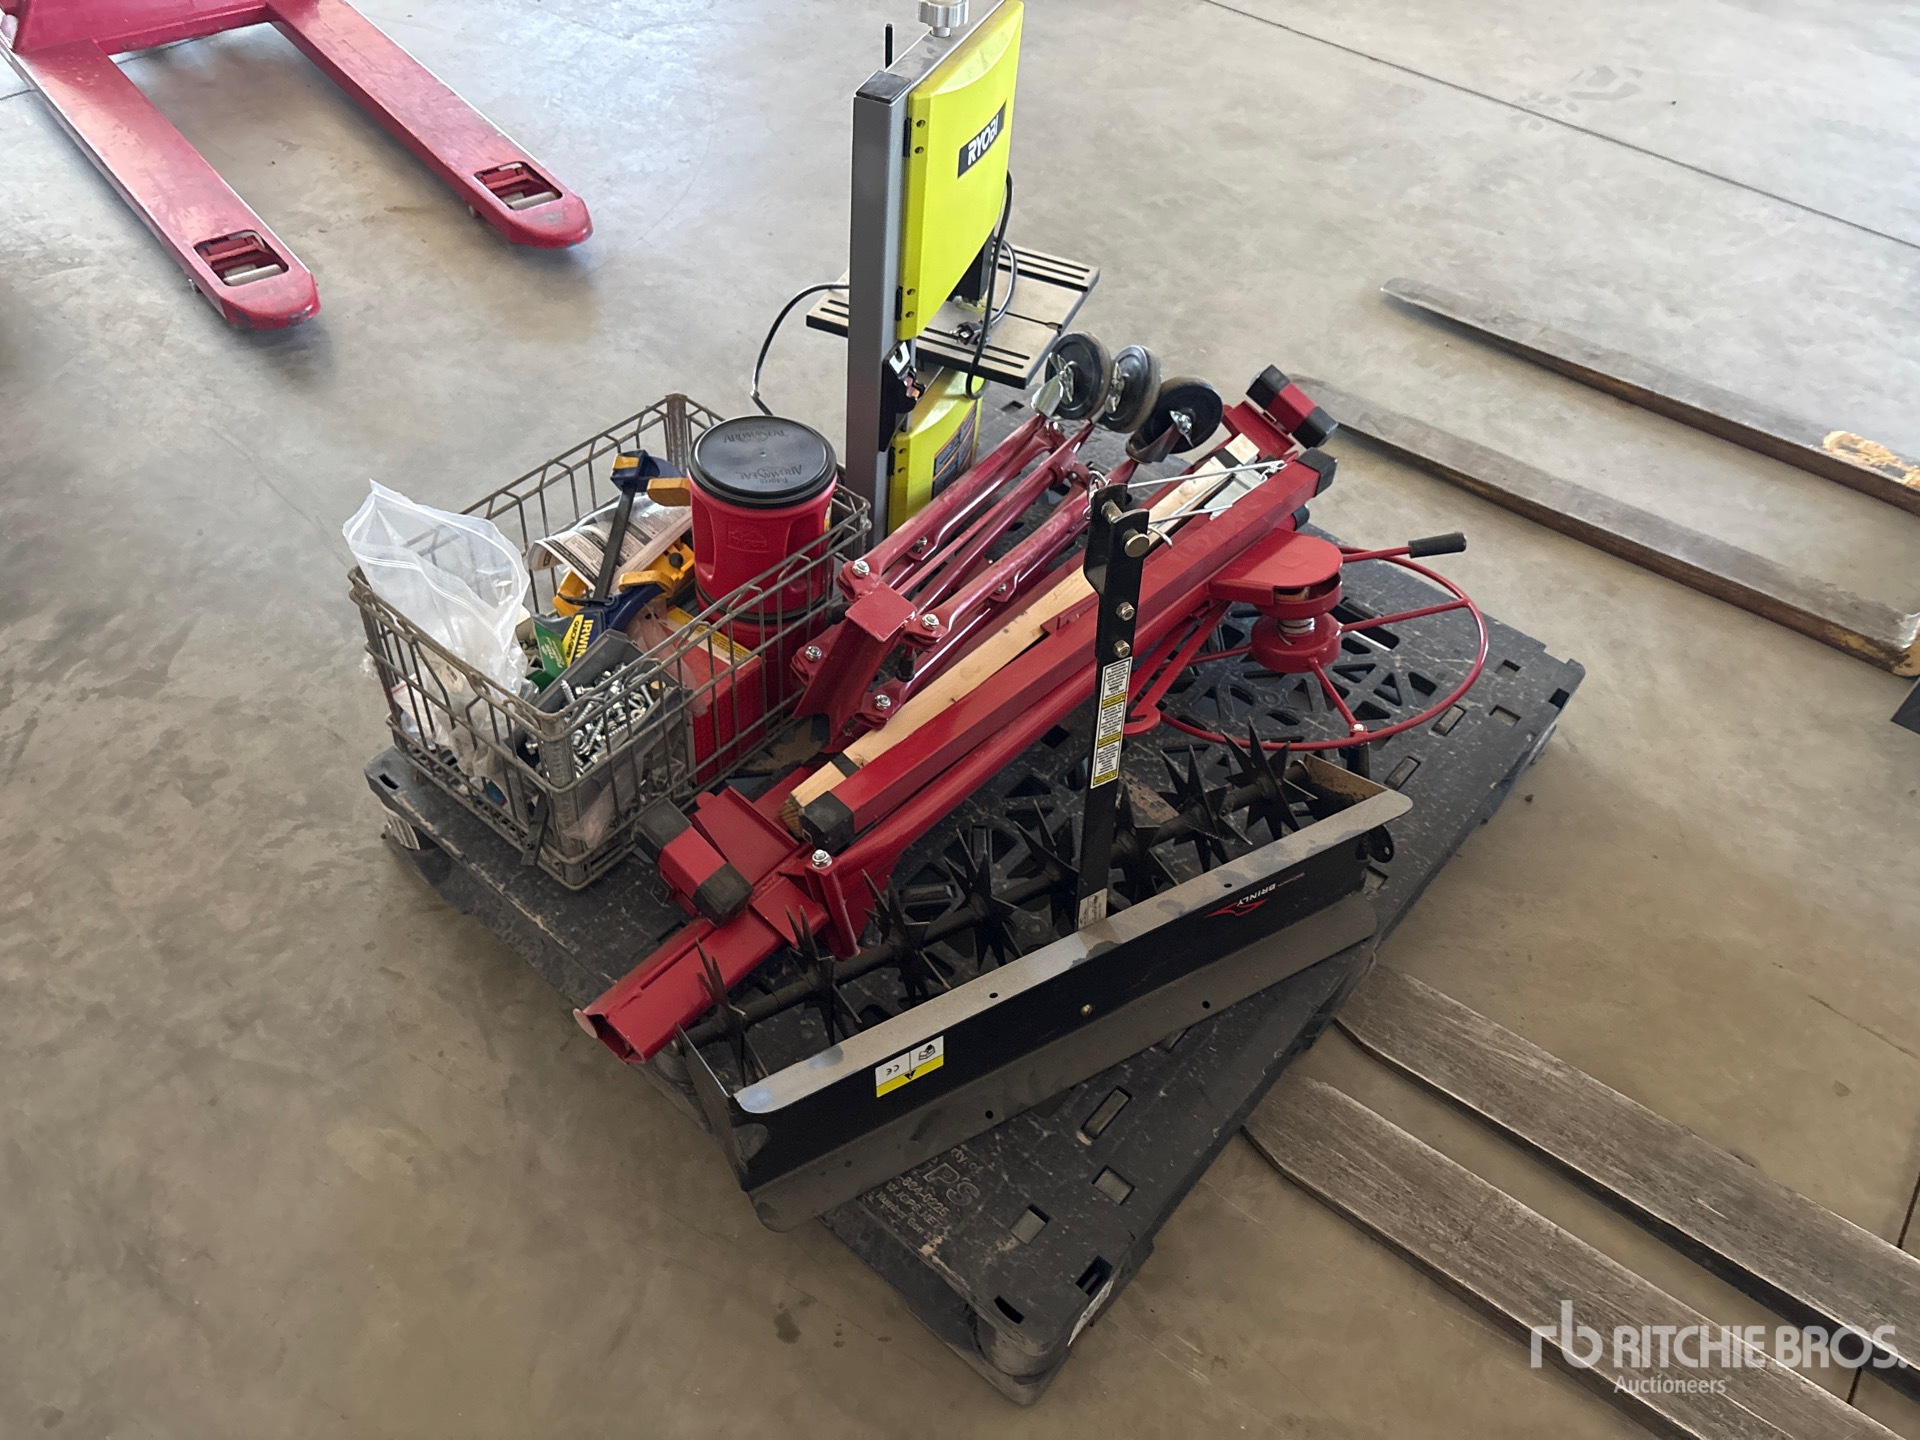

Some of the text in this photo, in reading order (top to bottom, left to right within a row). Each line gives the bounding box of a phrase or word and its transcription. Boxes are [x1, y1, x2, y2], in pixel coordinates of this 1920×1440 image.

[967, 114, 999, 166] RYOBI
[575, 619, 594, 659] IRWIN
[1236, 883, 1277, 907] BRINLY
